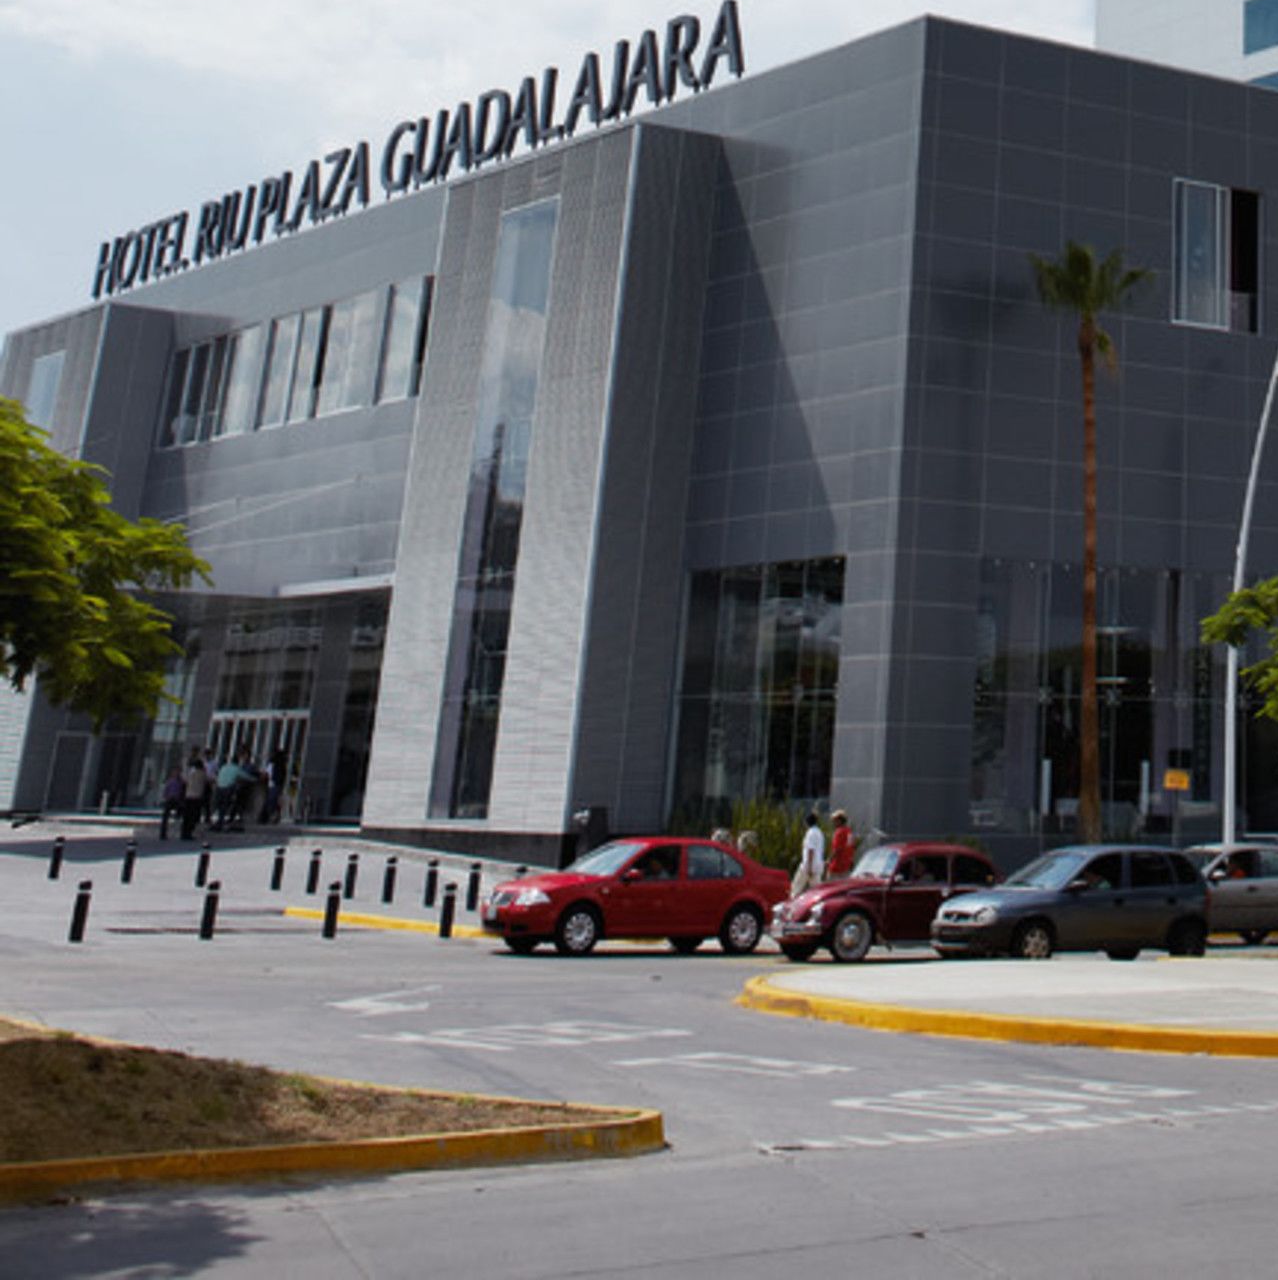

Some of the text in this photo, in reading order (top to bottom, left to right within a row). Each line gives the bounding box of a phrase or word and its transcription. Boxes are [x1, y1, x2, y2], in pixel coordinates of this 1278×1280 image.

[92, 211, 189, 299] HOTEL
[194, 184, 257, 264] RIU
[253, 141, 370, 244] PLAZA
